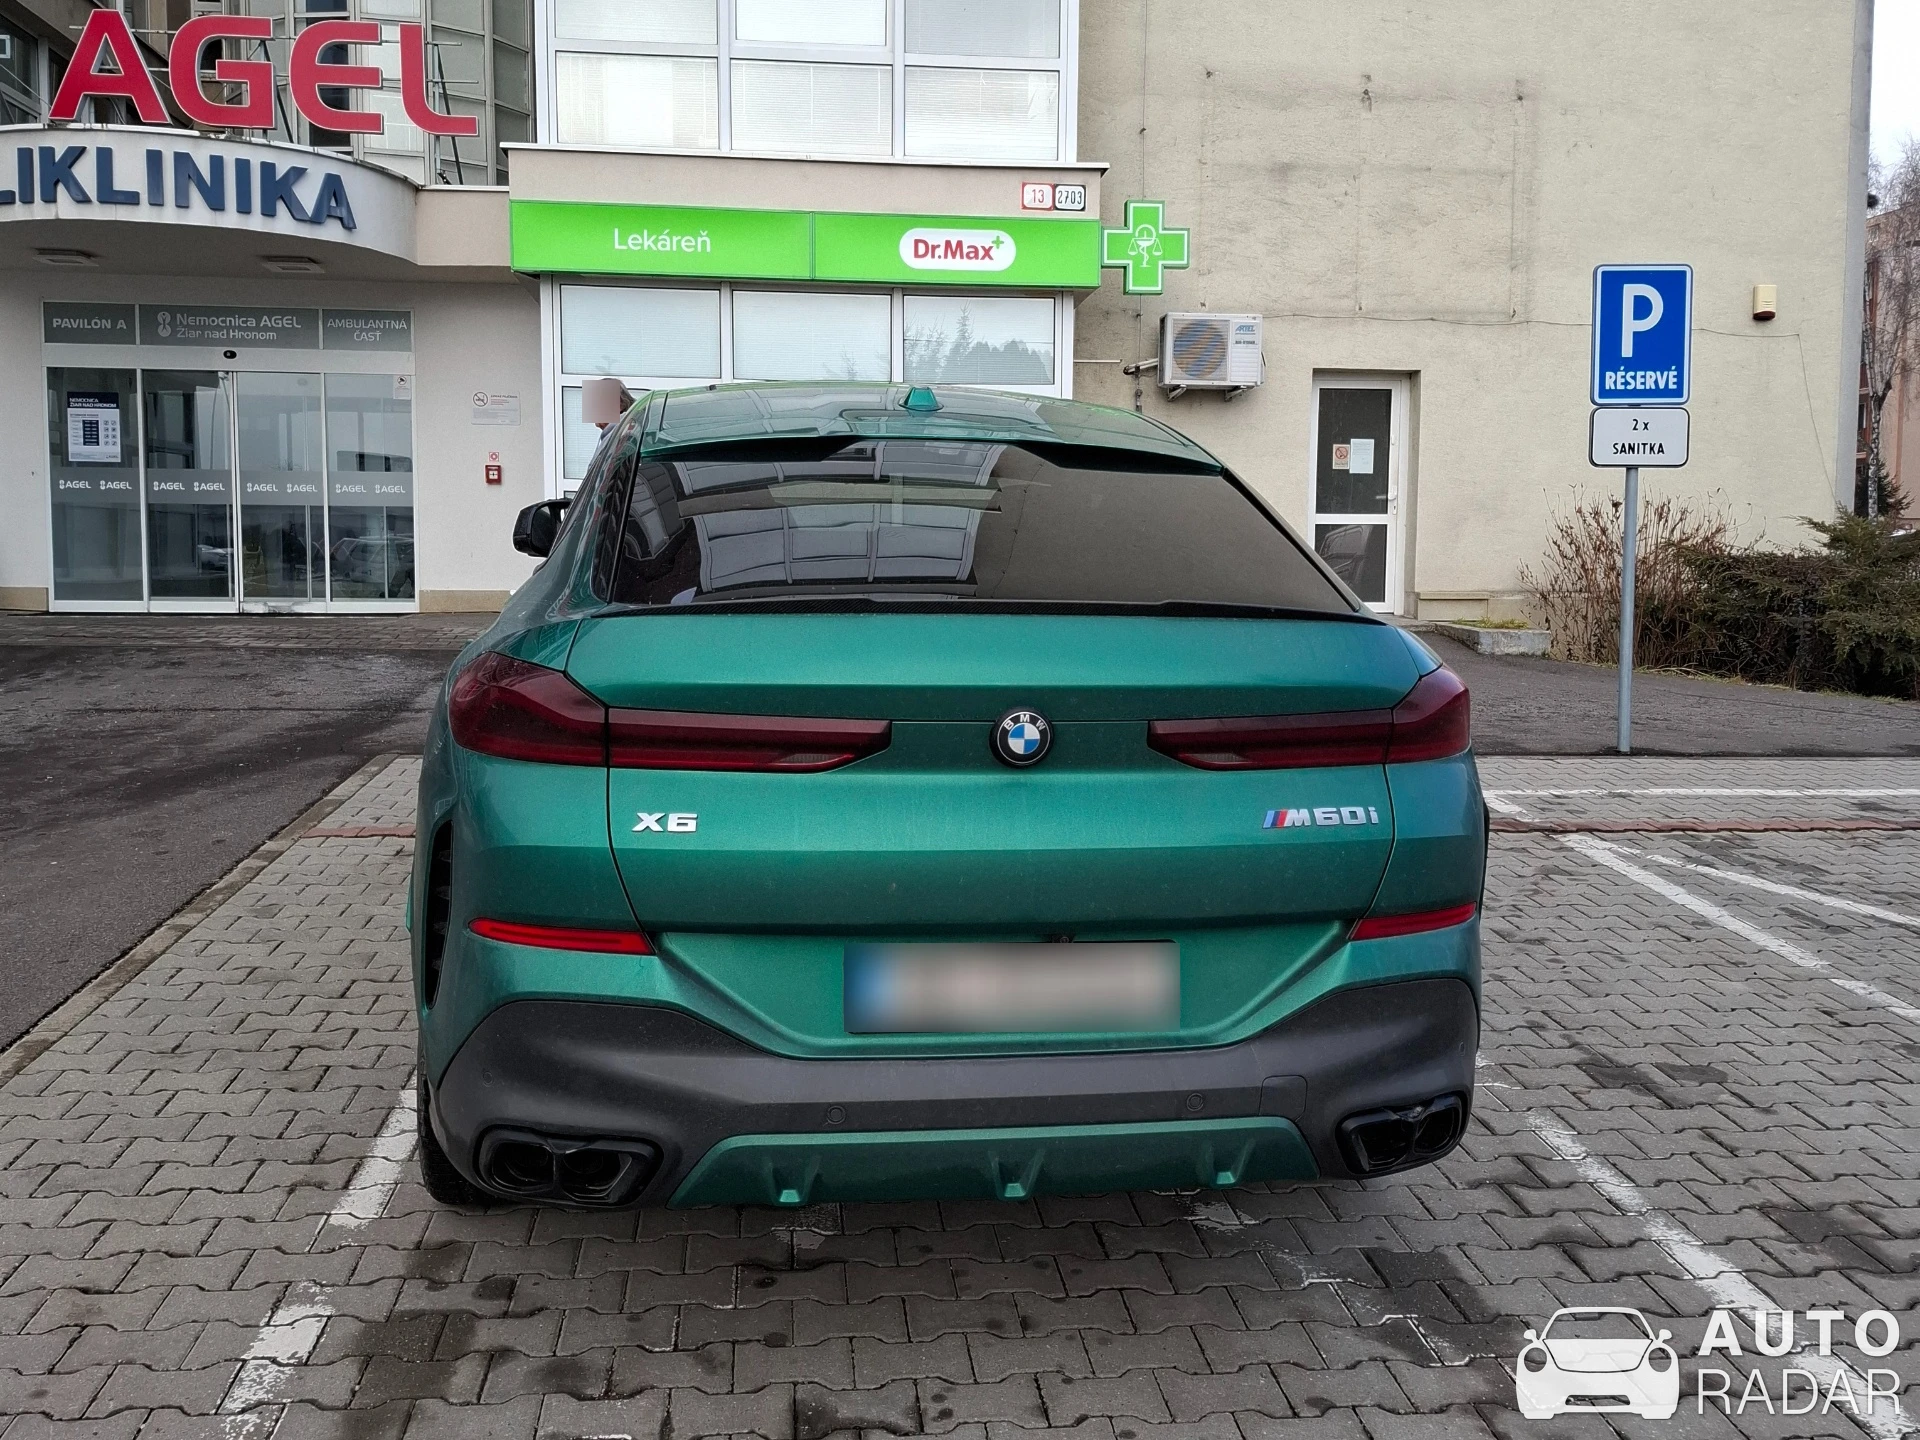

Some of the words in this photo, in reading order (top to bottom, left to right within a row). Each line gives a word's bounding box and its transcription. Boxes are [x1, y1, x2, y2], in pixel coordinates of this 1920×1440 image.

[48, 8, 479, 136] AGEL
[1032, 189, 1045, 203] 13
[1057, 190, 1082, 205] 2703
[614, 228, 711, 252] Lekáreň
[52, 316, 112, 329] PAVILÓN
[116, 319, 127, 330] A
[176, 313, 256, 327] Nemocnica
[260, 315, 302, 328] AGEL
[327, 318, 408, 330] AMBULANTNÁ
[1621, 283, 1664, 358] P
[176, 326, 202, 338] Žiar
[204, 329, 227, 339] nad
[229, 329, 277, 340] Hronom
[353, 330, 382, 341] ČASŤ
[1605, 366, 1678, 390] RÉSERVÉ
[1632, 418, 1639, 431] 2
[1612, 443, 1665, 455] SANITKA
[65, 480, 91, 489] AGEL
[106, 481, 132, 490] AGEL
[159, 482, 185, 491] AGEL
[199, 482, 226, 491] AGEL
[252, 483, 279, 492] AGEL
[292, 484, 318, 493] AGEL
[341, 484, 367, 493] AGEL
[380, 484, 406, 494] AGEL
[1003, 713, 1046, 731] BMW
[631, 812, 698, 833] X6
